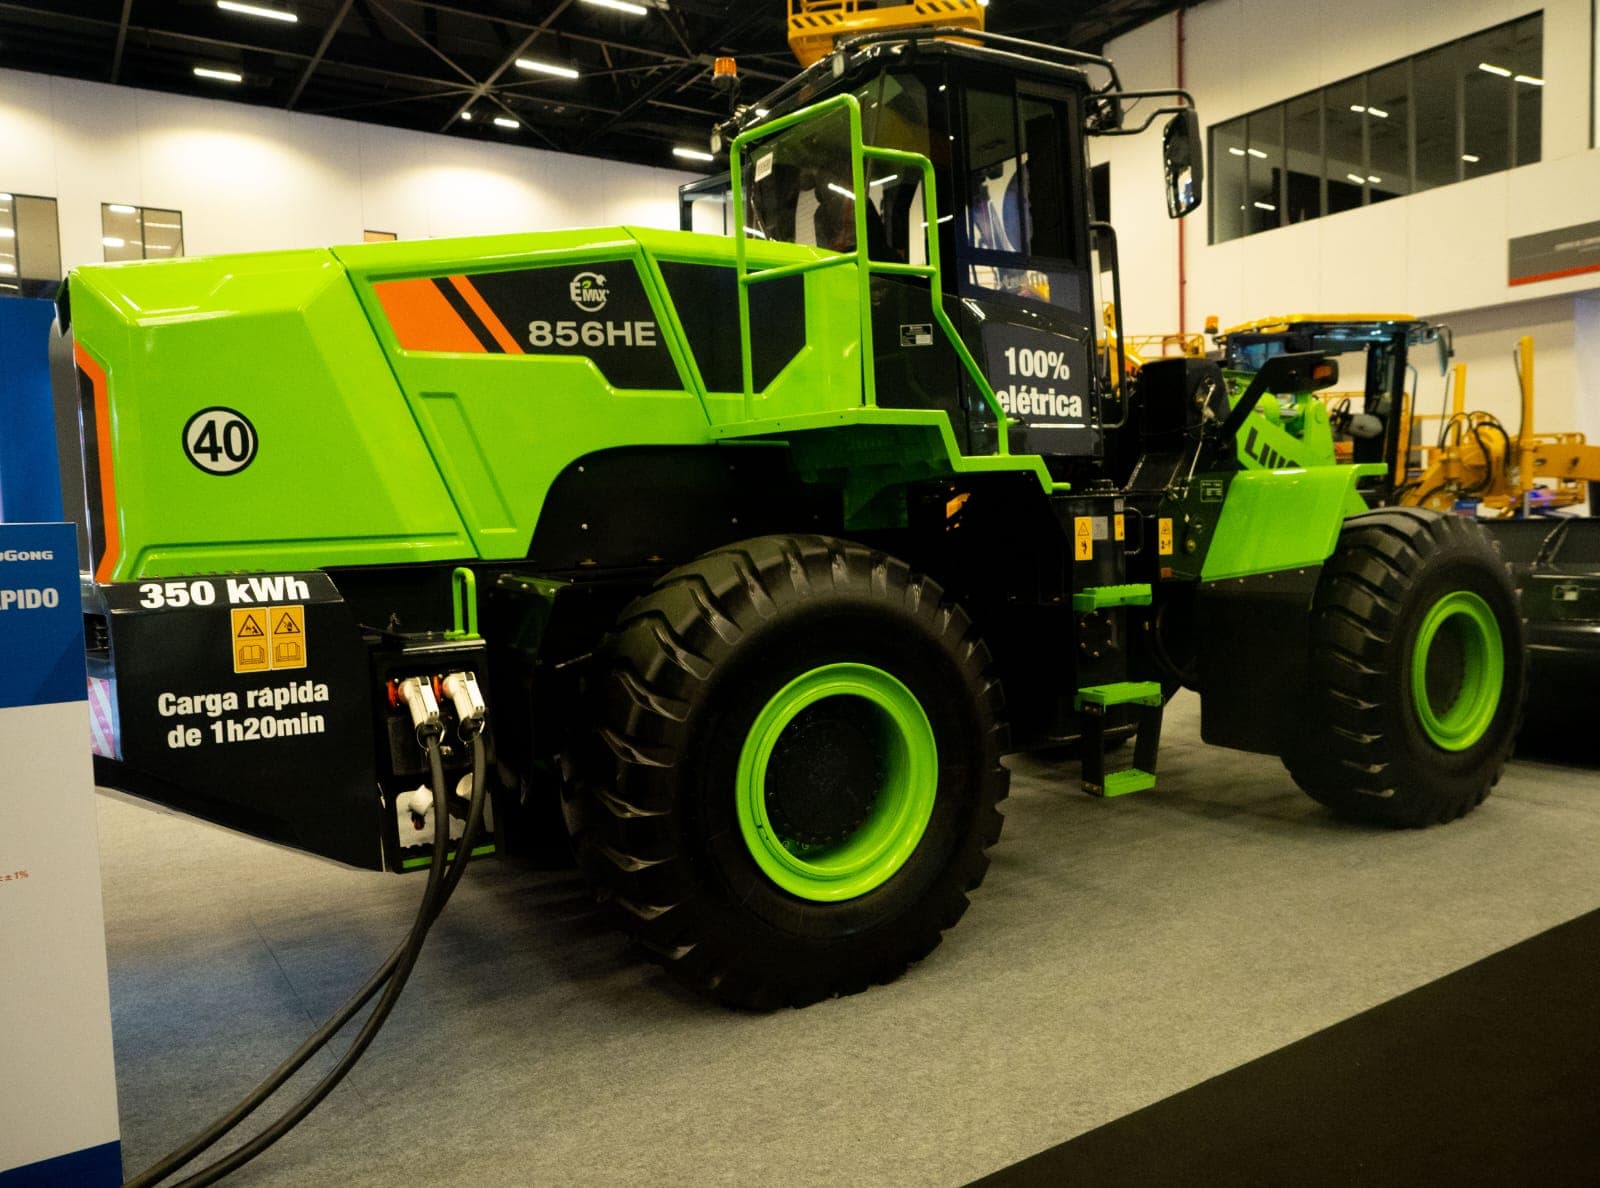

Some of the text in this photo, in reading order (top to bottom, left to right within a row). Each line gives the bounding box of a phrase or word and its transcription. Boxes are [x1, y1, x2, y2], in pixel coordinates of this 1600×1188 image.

[528, 320, 657, 347] 856HE
[1004, 346, 1071, 380] 100%
[995, 384, 1083, 417] elétrica
[193, 419, 250, 463] 40
[0, 587, 60, 611] PIDO
[138, 576, 311, 609] 350 kWh
[157, 680, 330, 718] Carga rápida
[167, 712, 326, 749] de 1h20min
